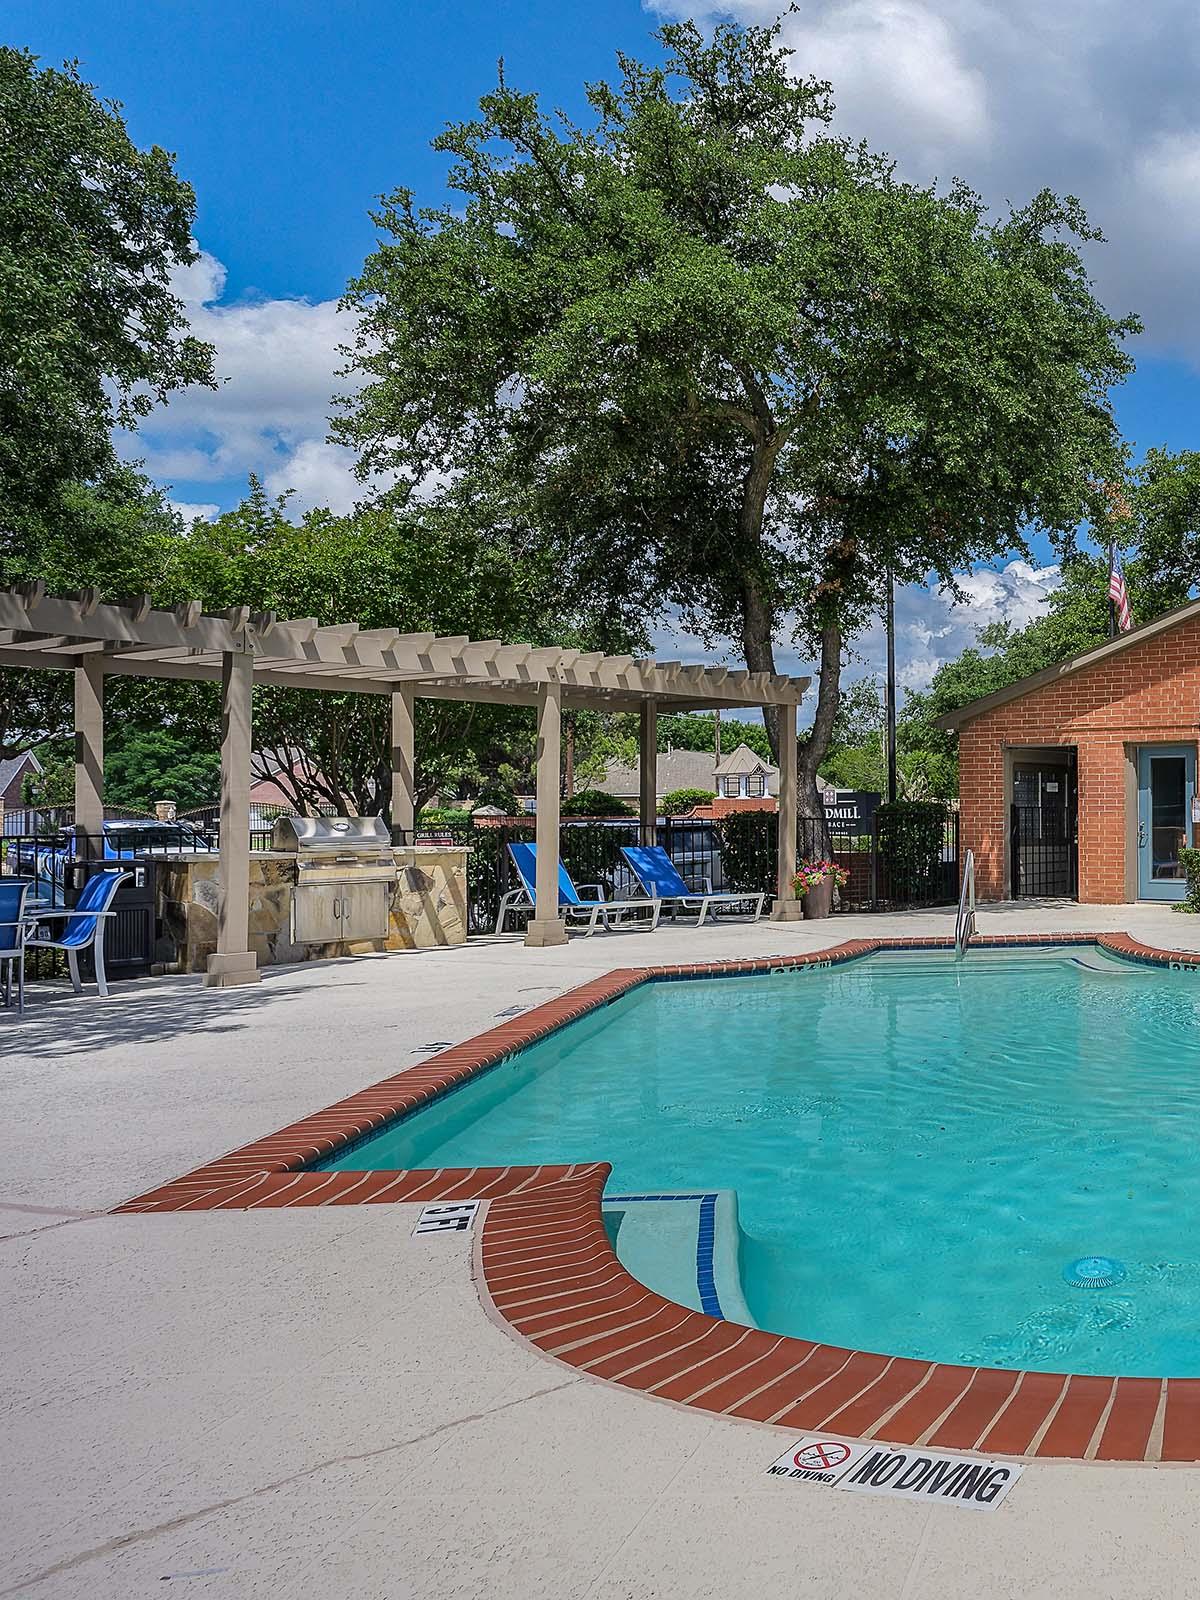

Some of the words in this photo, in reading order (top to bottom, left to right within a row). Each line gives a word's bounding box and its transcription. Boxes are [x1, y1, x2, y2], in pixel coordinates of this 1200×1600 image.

[824, 806, 861, 819] DMILL
[416, 1216, 471, 1234] FT
[766, 1465, 790, 1476] NO
[788, 1468, 836, 1483] DIVING
[848, 1452, 907, 1487] NO
[891, 1457, 1011, 1503] DIVING
